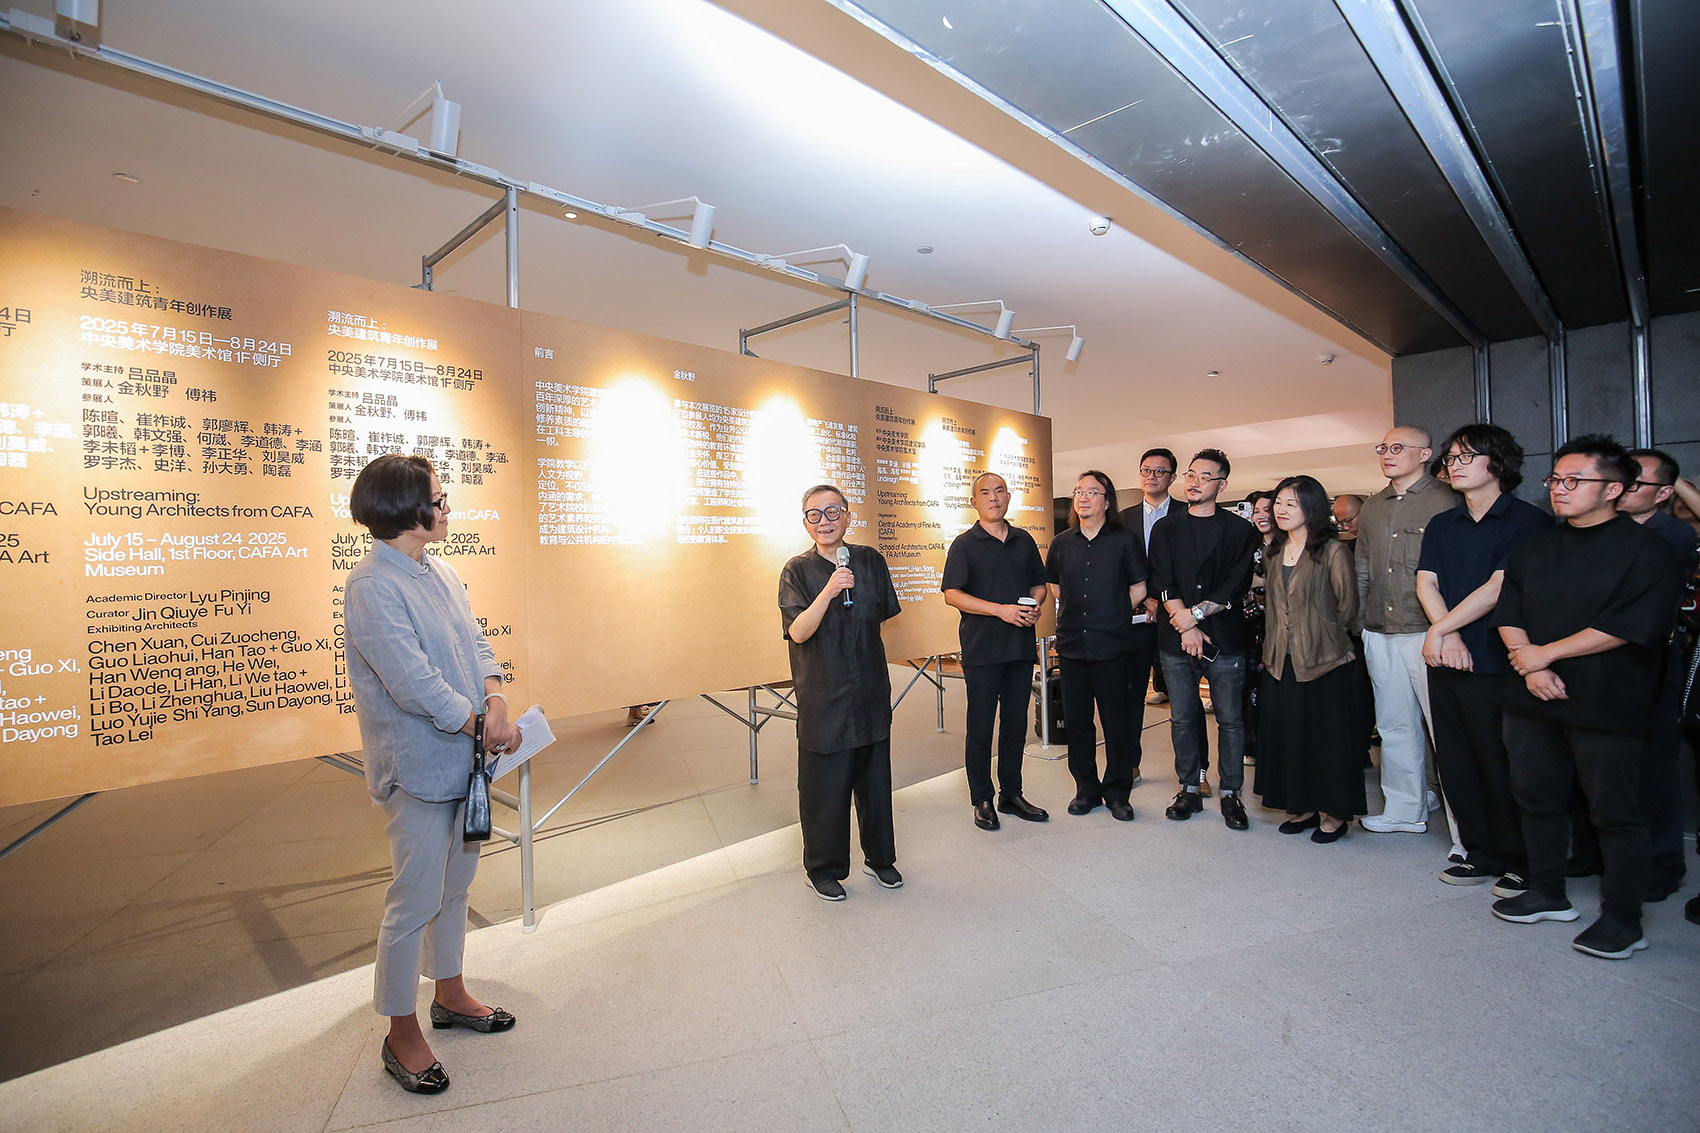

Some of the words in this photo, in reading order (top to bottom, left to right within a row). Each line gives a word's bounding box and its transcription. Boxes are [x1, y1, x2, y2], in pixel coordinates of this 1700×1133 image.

[80, 286, 232, 321] 央美建筑青年创作展
[327, 323, 439, 352] 央美建筑青年创作展
[534, 347, 554, 360] 前言
[81, 362, 124, 375] 学术主持
[128, 367, 177, 385] 吕品晶
[673, 369, 696, 382] 金秋野
[81, 377, 114, 389] 策展人
[118, 381, 169, 398] 金秋野
[81, 393, 114, 404] 参展人
[83, 486, 200, 505] Upstreaming:
[84, 502, 142, 519] Young
[146, 503, 229, 517] Architects
[232, 504, 268, 517] from
[271, 505, 313, 518] CAFA
[467, 508, 500, 521] CAFA
[83, 532, 121, 550] July
[124, 532, 144, 546] 15
[160, 532, 220, 549] August
[222, 532, 243, 545] 24
[248, 532, 287, 545] 2025
[331, 533, 358, 546] July
[451, 533, 480, 544] 2025
[18, 550, 50, 564] Art
[84, 547, 126, 562] Side
[129, 546, 166, 563] Hall,
[168, 546, 190, 560] 1st
[193, 546, 236, 561] Floor,
[238, 546, 283, 559] CAFA
[285, 545, 308, 558] Art
[331, 546, 361, 557] Side
[443, 545, 477, 556] CAFA
[479, 545, 496, 555] Art
[85, 563, 165, 577] Museum
[86, 594, 143, 603] Academic
[144, 592, 187, 601] Director
[190, 591, 217, 606] Lyu
[221, 589, 270, 604] Pinjing
[86, 610, 130, 619] Curator
[132, 607, 157, 621] Jin
[160, 606, 208, 621] Qiuye
[214, 604, 233, 616] Fu
[236, 602, 251, 615] Yi
[87, 624, 142, 634] Exhibiting
[144, 620, 198, 631] Architects
[88, 640, 137, 654] Chen
[141, 637, 188, 650] Xuan,
[191, 633, 218, 647] Cui
[220, 629, 300, 645] Zuocheng,
[88, 656, 128, 669] Guo
[133, 649, 199, 666] Liaohui,
[201, 647, 234, 660] Han
[237, 644, 266, 657] Tao
[281, 641, 312, 653] Guo
[315, 638, 332, 651] Xi,
[8, 662, 53, 677] Guo
[57, 658, 81, 674] Xi,
[90, 671, 126, 686] Han
[223, 660, 245, 672] He
[247, 657, 280, 670] Wei,
[90, 687, 104, 701] Li
[108, 682, 171, 699] Daode,
[174, 679, 187, 692] Li
[190, 677, 227, 690] Han,
[230, 674, 242, 686] Li
[91, 702, 105, 716] Li
[109, 700, 138, 714] Bo,
[142, 697, 156, 710] Li
[160, 690, 247, 708] Zhenghua,
[250, 685, 272, 698] Liu
[275, 679, 333, 695] Haowei,
[0, 705, 81, 728] Haowei,
[91, 718, 124, 733] Luo
[127, 712, 167, 729] Yujie
[173, 707, 198, 722] Shi
[201, 704, 244, 718] Yang,
[246, 699, 275, 713] Sun
[278, 692, 333, 709] Dayong,
[2, 723, 79, 744] Dayong
[90, 733, 125, 746] Tao
[128, 728, 153, 742] Lei
